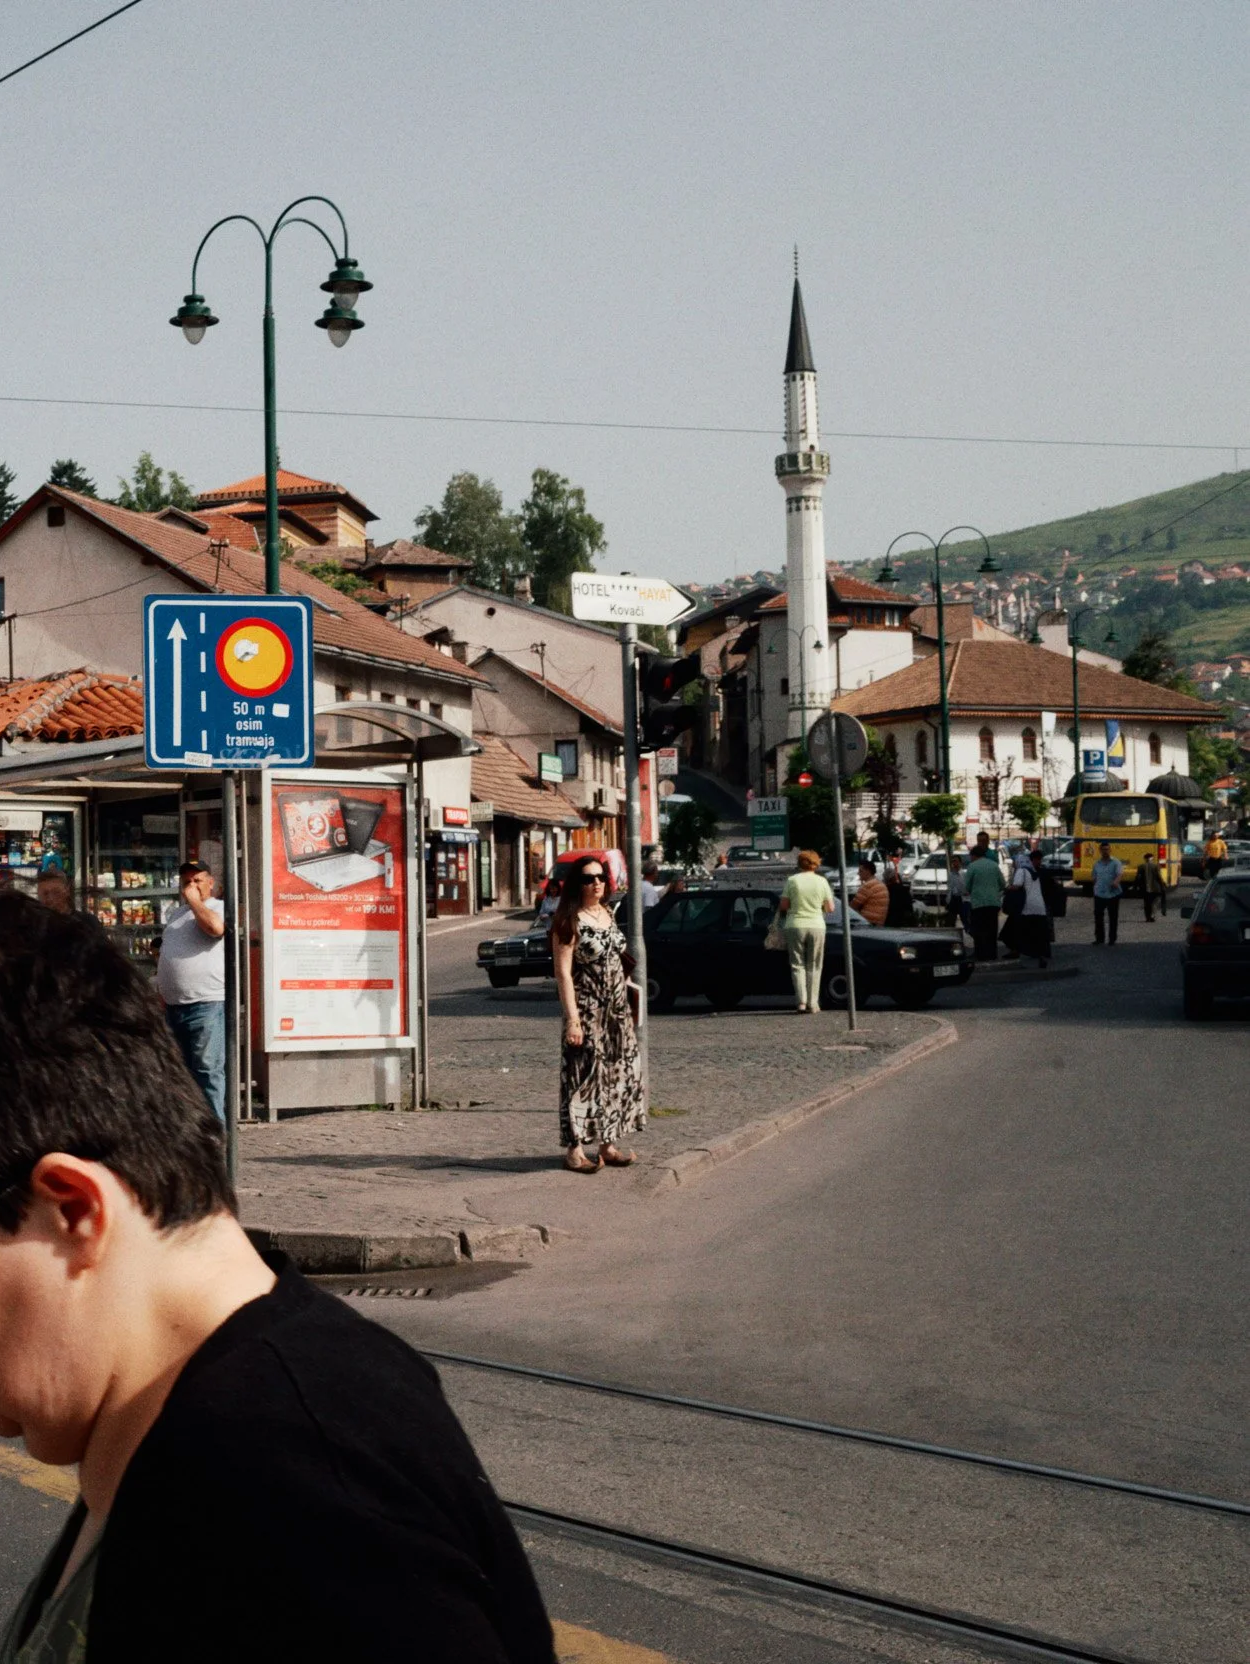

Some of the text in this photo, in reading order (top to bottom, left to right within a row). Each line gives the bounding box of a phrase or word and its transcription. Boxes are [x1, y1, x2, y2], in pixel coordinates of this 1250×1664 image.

[573, 582, 674, 602] HOTEL HAYAT
[609, 603, 645, 617] Kovači
[233, 701, 266, 716] 50 m
[235, 717, 263, 731] osim
[757, 799, 781, 812] TAXI
[362, 904, 377, 914] 199
[379, 904, 396, 914] KM!
